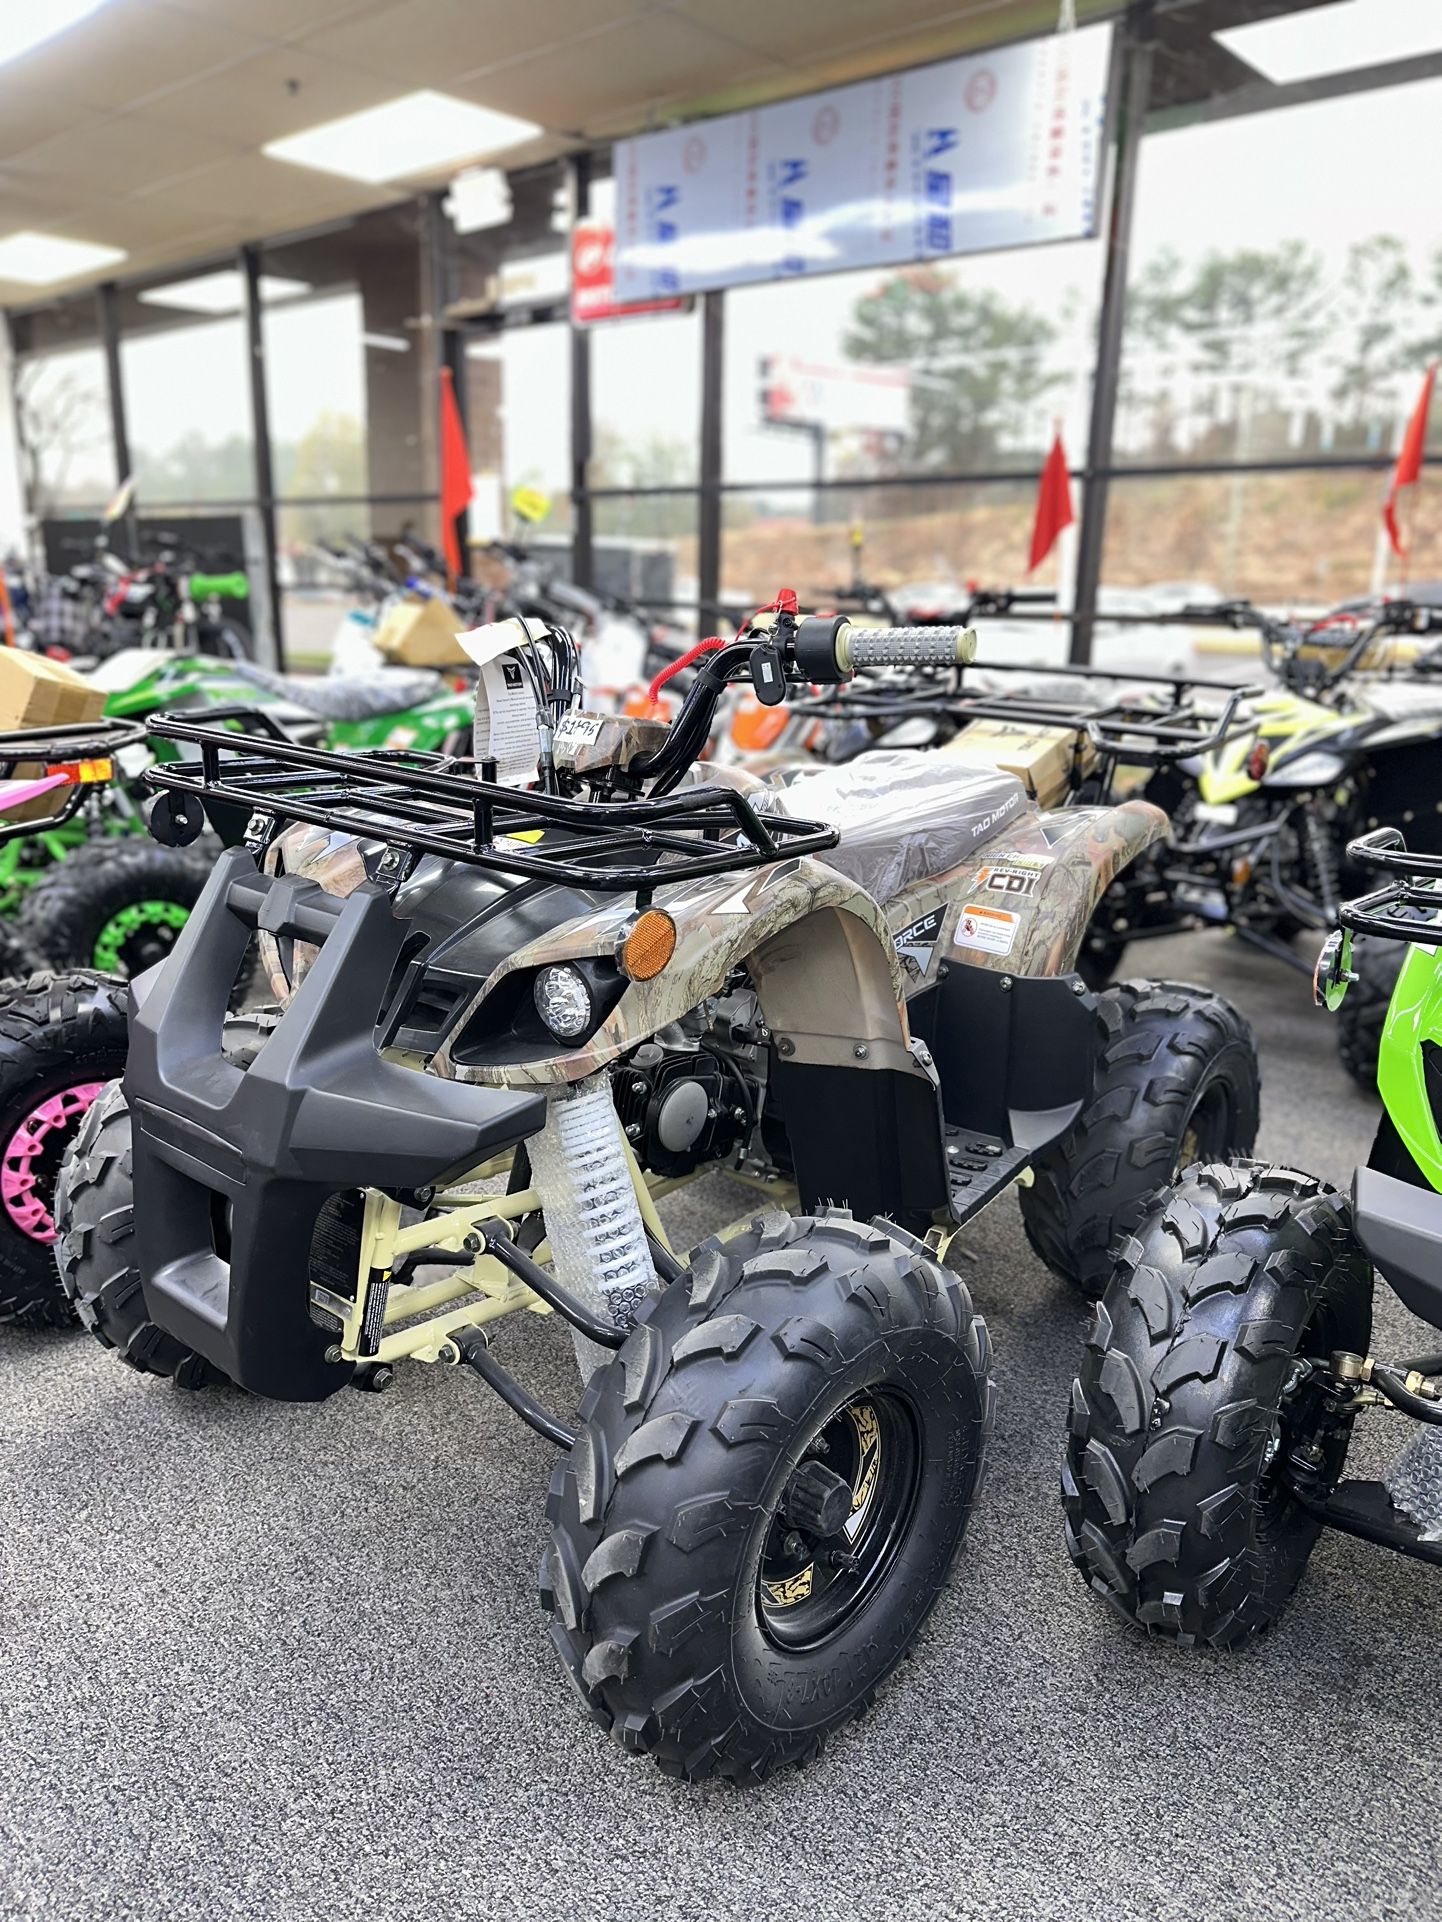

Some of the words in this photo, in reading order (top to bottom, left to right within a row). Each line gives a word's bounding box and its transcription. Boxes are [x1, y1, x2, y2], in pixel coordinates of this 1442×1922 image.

[971, 816, 991, 838] TAO
[991, 792, 1019, 824] MOTOR
[987, 873, 1036, 895] CDI
[993, 867, 1041, 878] REV-RIGHT
[894, 914, 937, 950] ORCE
